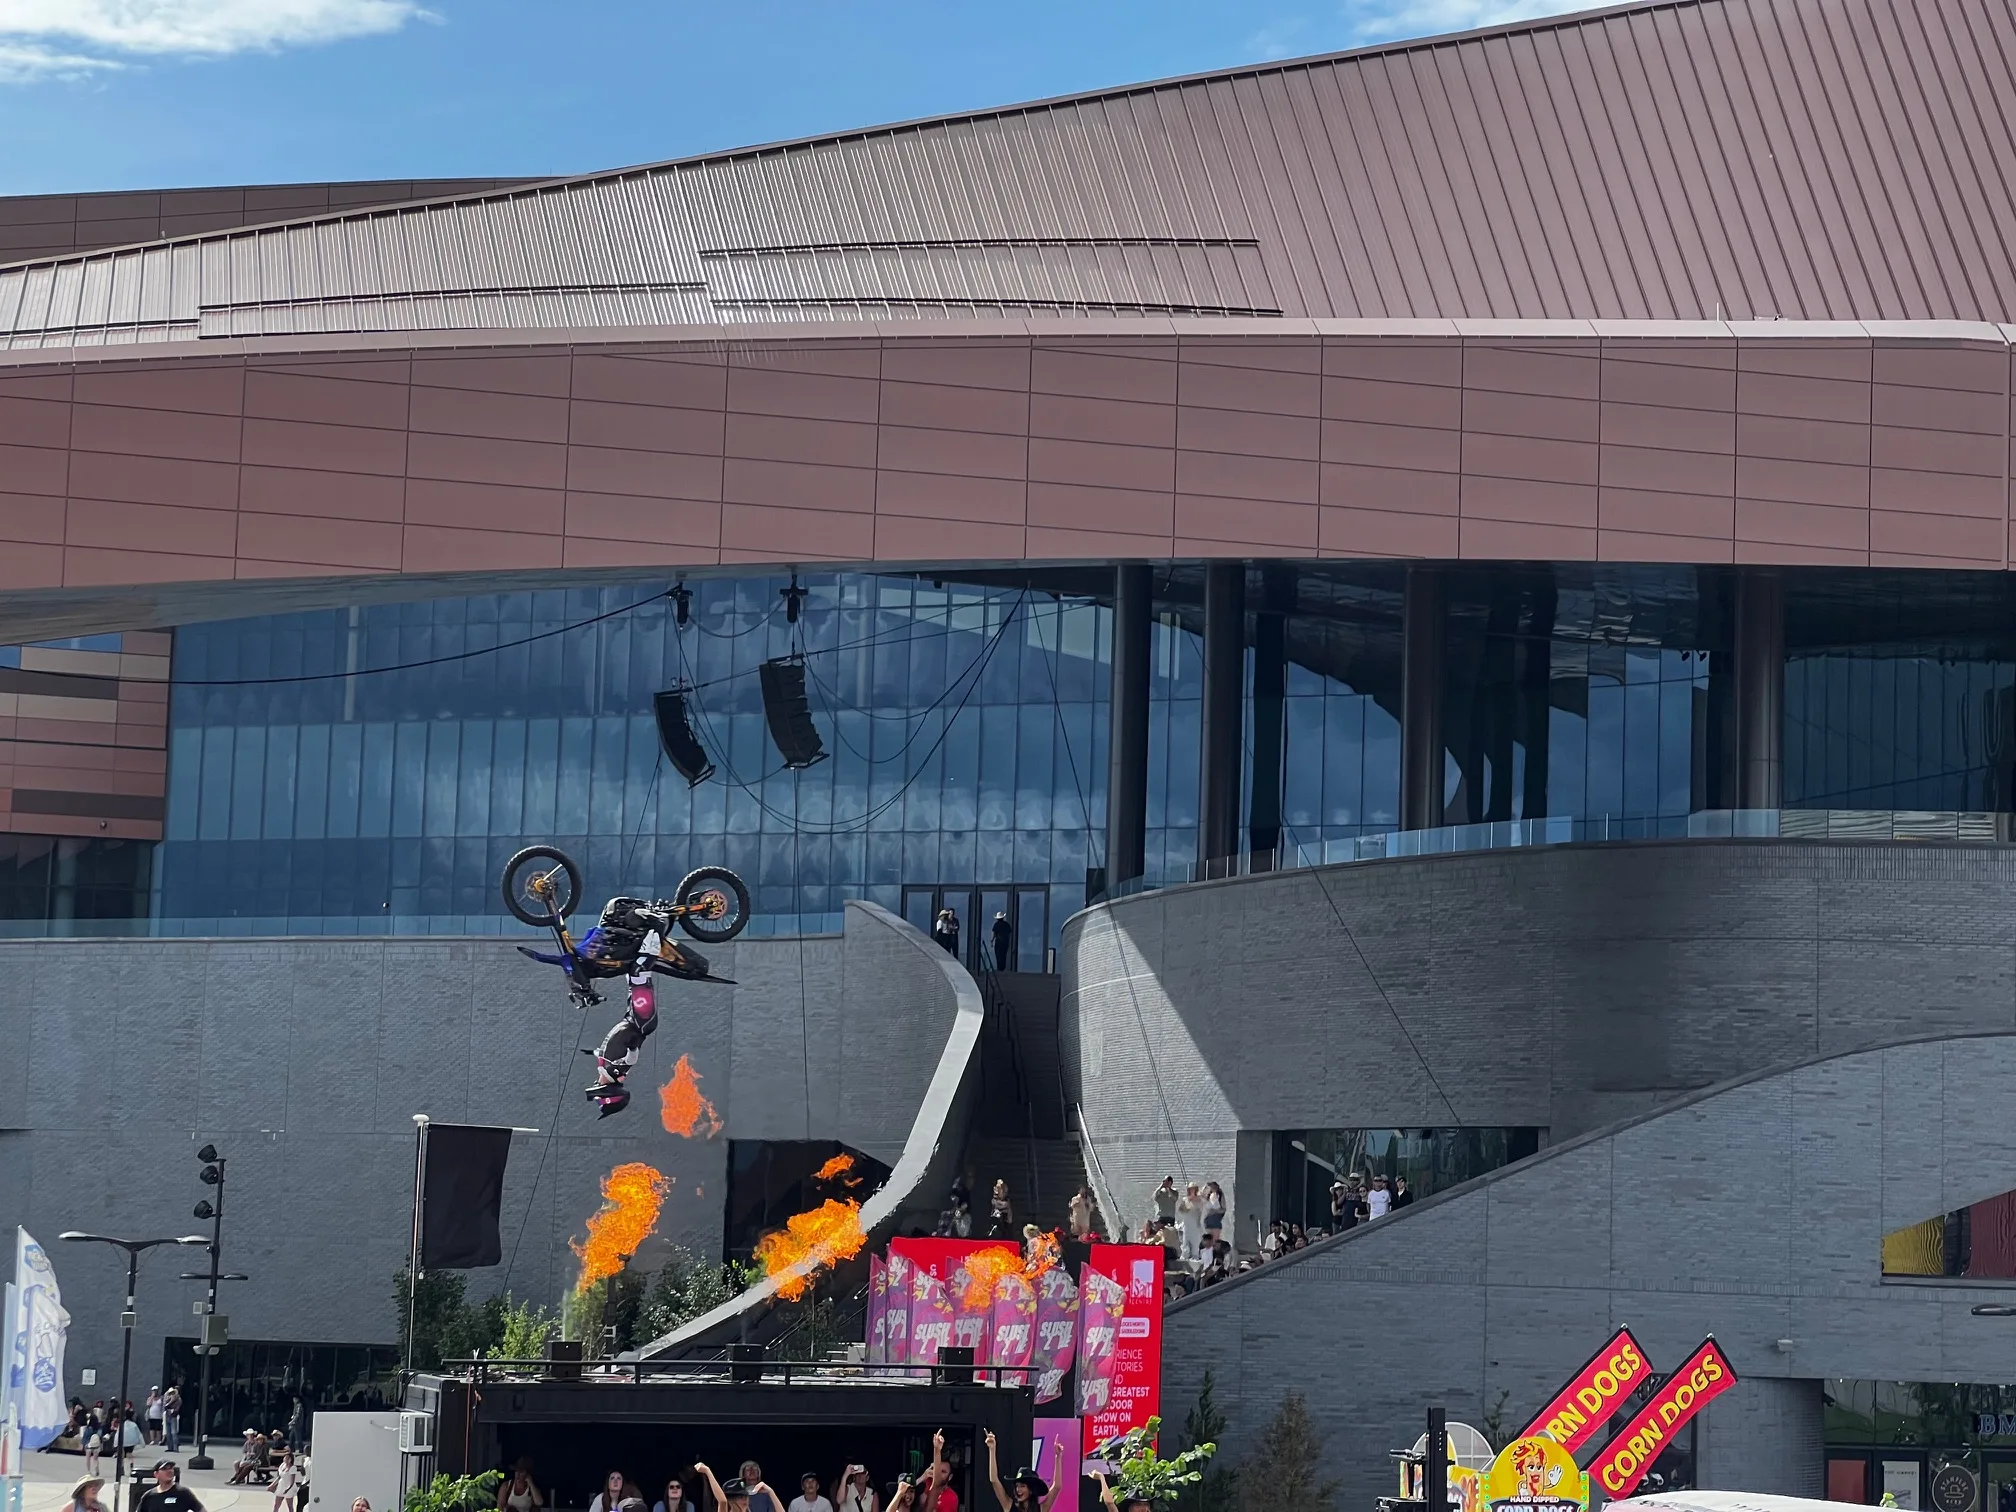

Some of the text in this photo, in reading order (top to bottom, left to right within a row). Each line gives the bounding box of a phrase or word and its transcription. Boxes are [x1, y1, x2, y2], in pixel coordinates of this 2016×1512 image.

[1117, 1349, 1142, 1359] RIENCE
[1117, 1361, 1143, 1372] TORIES
[1114, 1374, 1123, 1384] ND
[1546, 1343, 1641, 1444] RN DOGS
[1109, 1399, 1133, 1410] DOOR
[1093, 1412, 1131, 1423] SHOW ON
[1602, 1354, 1724, 1492] CORN DOGS
[1093, 1425, 1119, 1436] EARTH
[1532, 1496, 1560, 1504] DIPPED
